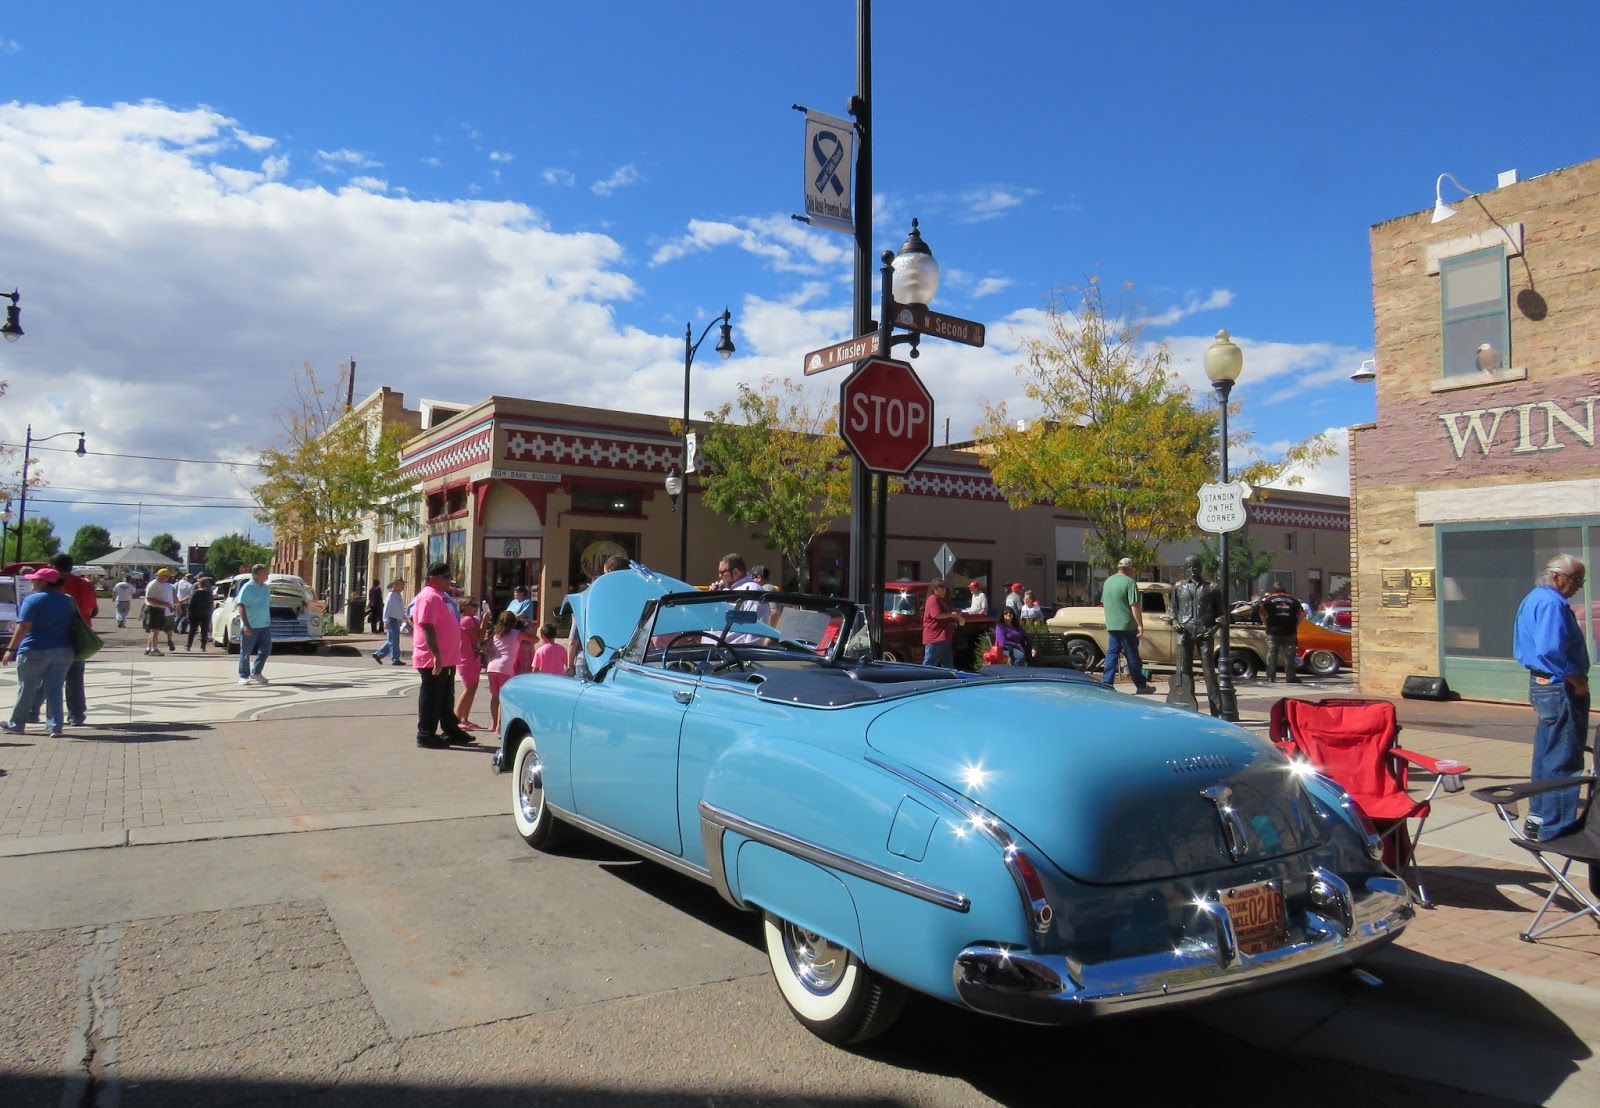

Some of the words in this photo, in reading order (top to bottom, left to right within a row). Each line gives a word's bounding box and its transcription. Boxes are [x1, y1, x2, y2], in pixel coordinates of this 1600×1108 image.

[824, 198, 839, 218] Prevention
[924, 315, 931, 328] W
[935, 317, 968, 339] Second
[828, 351, 834, 363] N
[836, 343, 867, 362] Kinsley
[850, 392, 925, 439] STOP
[510, 471, 527, 479] BANK
[531, 472, 560, 481] BUILDING
[1204, 492, 1238, 502] STANDIN'
[1208, 504, 1218, 512] ON
[1220, 503, 1234, 511] THE
[1206, 513, 1236, 522] CORNER
[505, 547, 519, 557] 66
